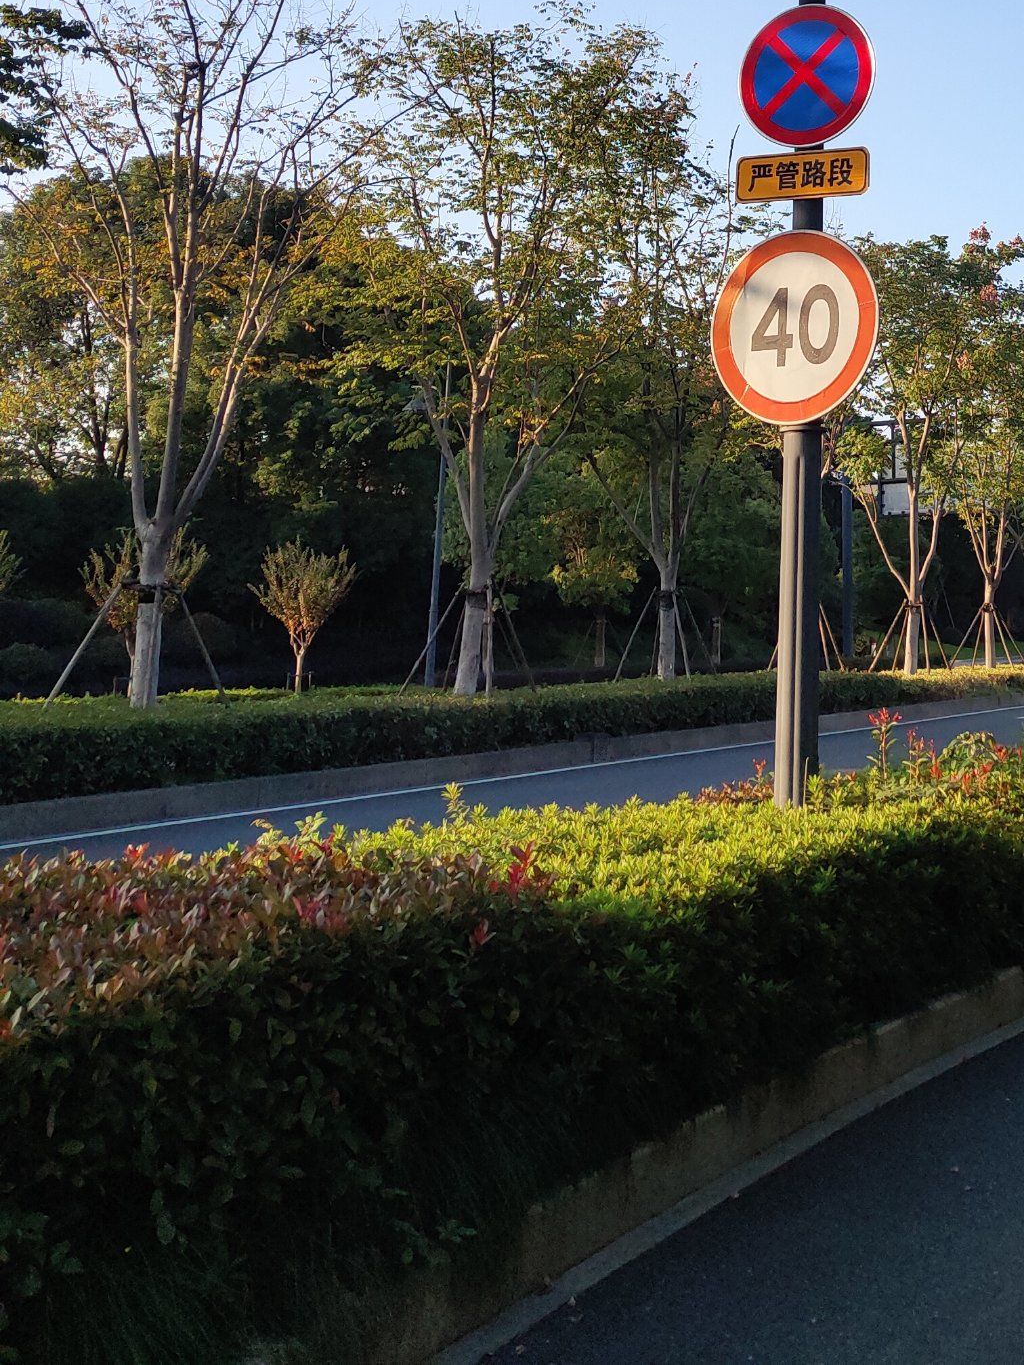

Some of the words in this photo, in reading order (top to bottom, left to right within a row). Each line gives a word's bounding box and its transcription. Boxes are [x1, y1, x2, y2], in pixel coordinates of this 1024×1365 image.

[748, 157, 854, 193] 严管路段
[750, 284, 840, 368] 40
